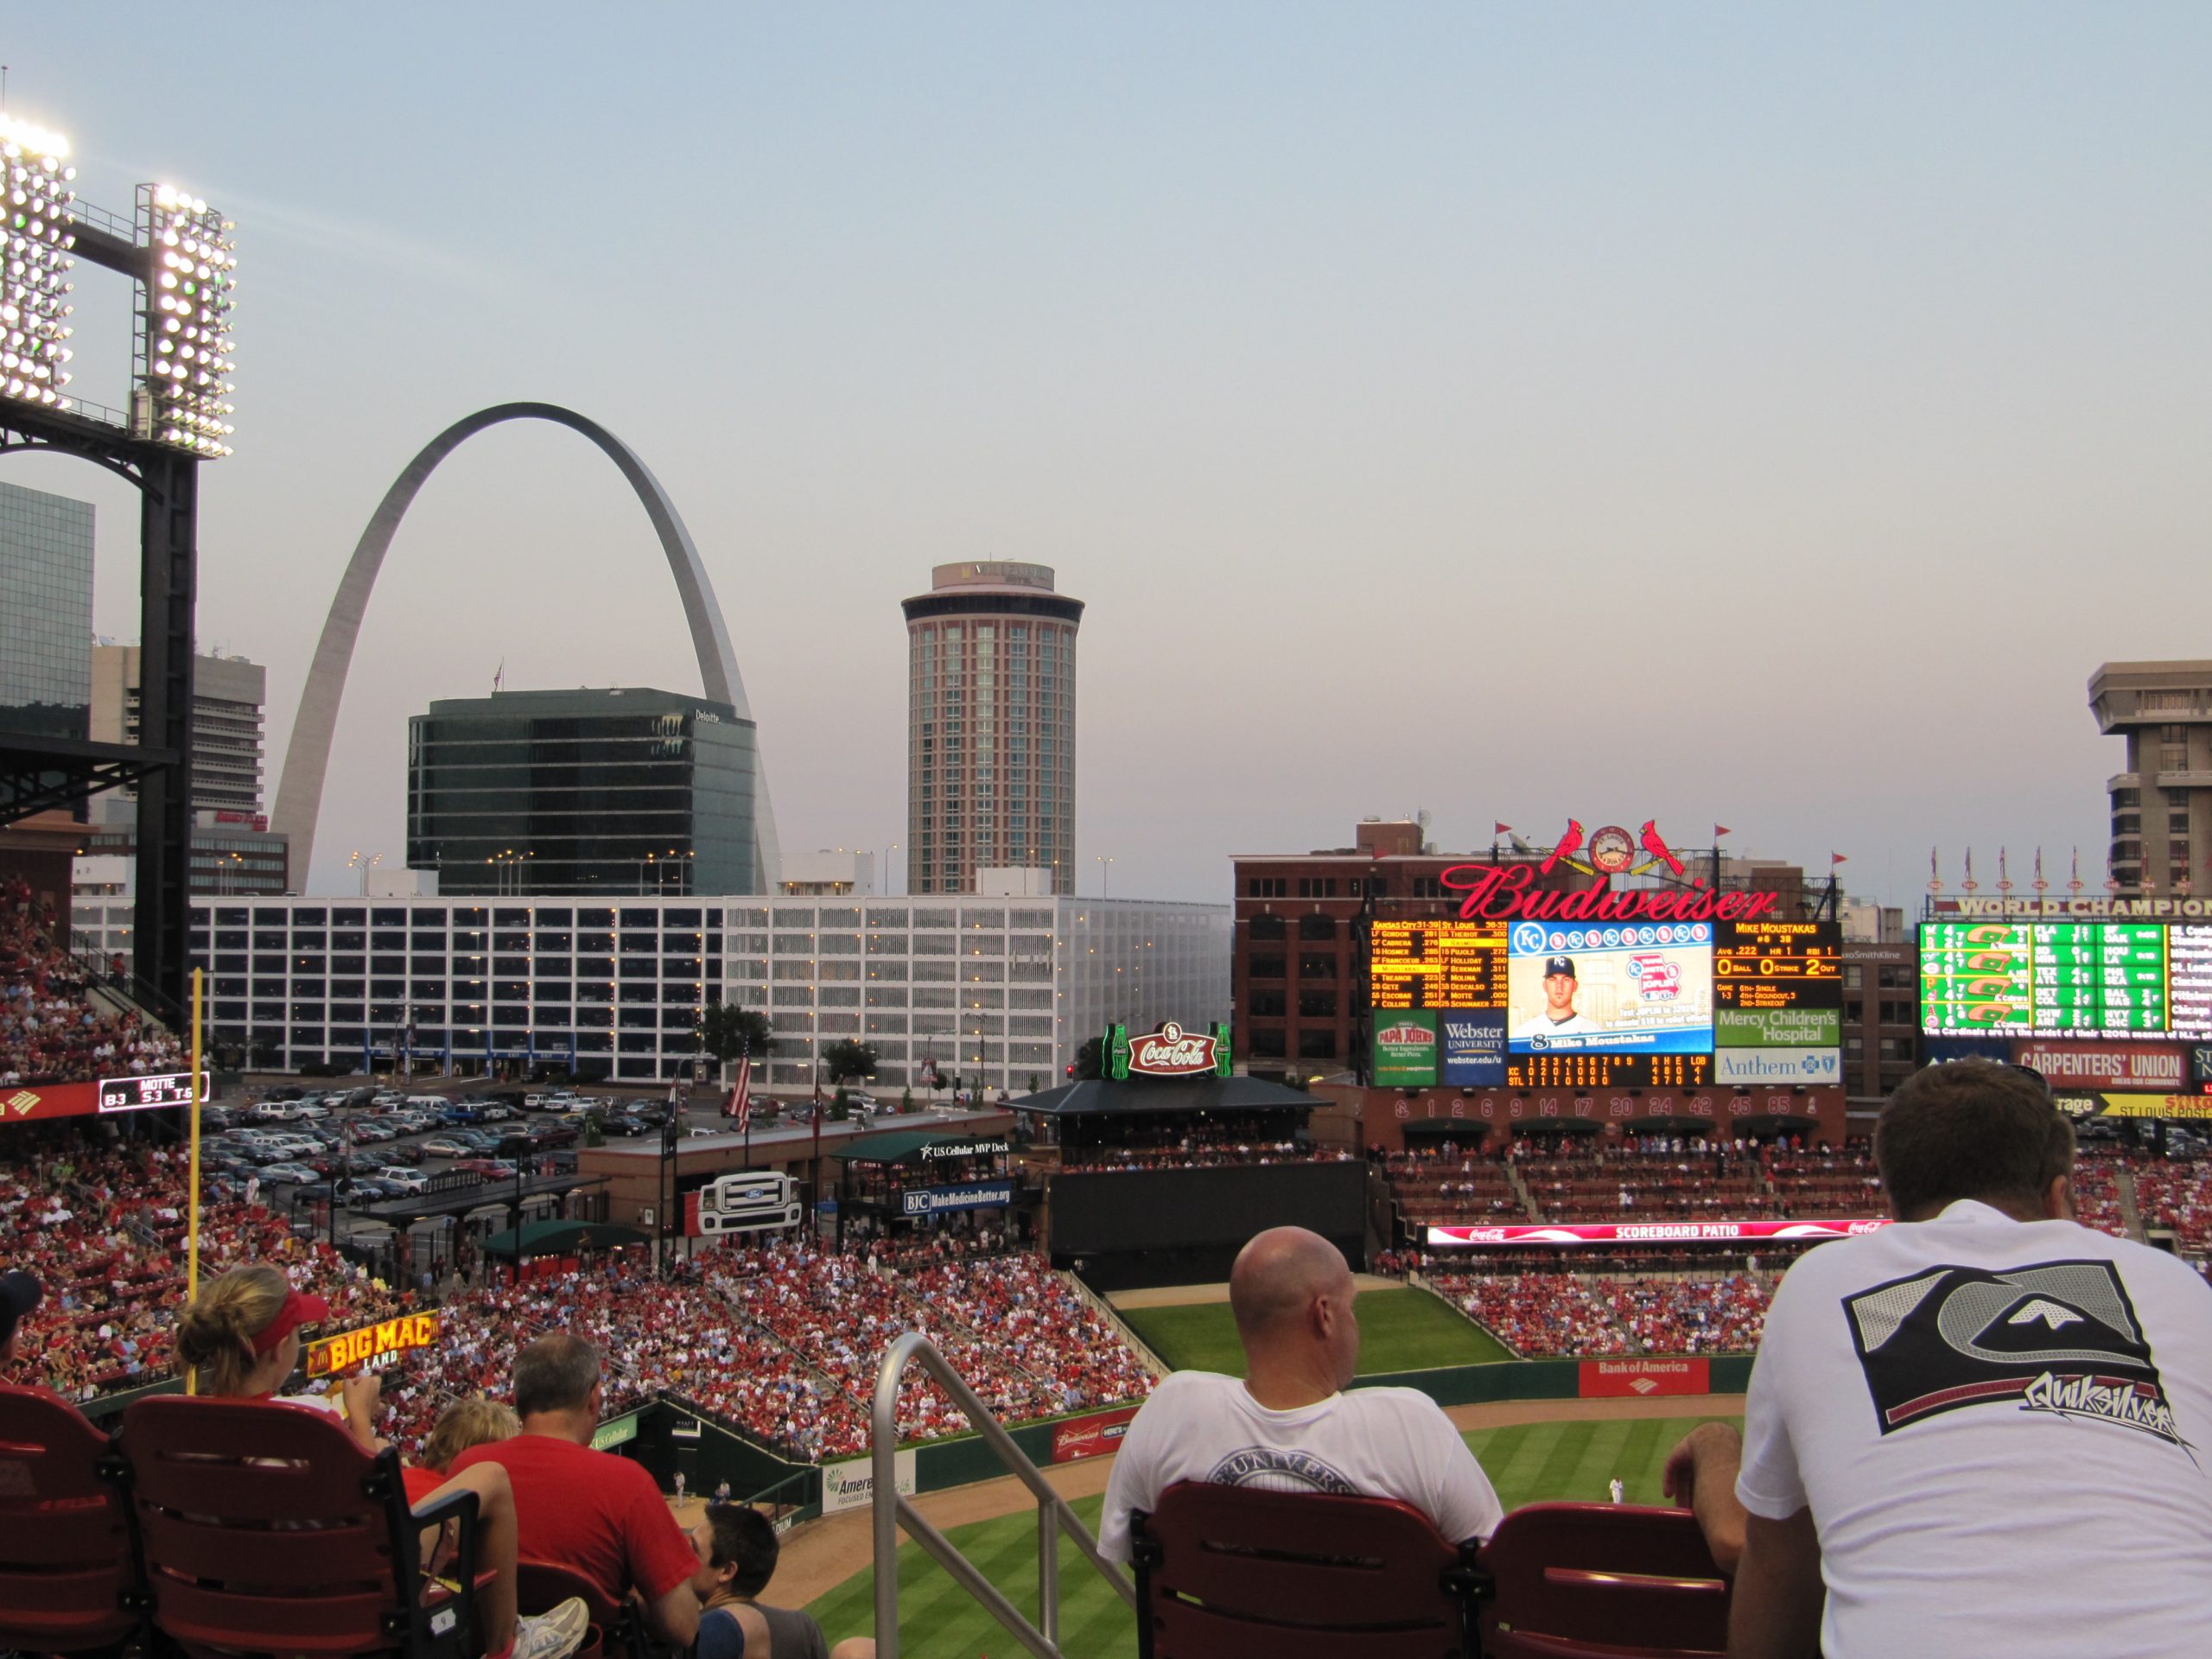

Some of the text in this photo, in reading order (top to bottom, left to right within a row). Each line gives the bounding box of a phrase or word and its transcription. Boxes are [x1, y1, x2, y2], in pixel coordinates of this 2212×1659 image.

[696, 709, 720, 724] Deloitte
[1440, 864, 1777, 920] Budweiser
[1957, 899, 2060, 916] WORLD
[1736, 923, 1816, 933] MIKE MOUSTAKAS
[1806, 959, 1820, 975] 2
[1719, 1012, 1764, 1027] Mercy
[1770, 1011, 1836, 1026] Children's
[1379, 1028, 1402, 1044] PAPA
[1445, 1023, 1503, 1039] Webster
[1763, 1027, 1821, 1044] Hospital
[1923, 1027, 1940, 1036] The
[1942, 1027, 1986, 1036] Cardinals
[2005, 1027, 2014, 1036] in
[2017, 1027, 2032, 1036] the
[2034, 1028, 2063, 1037] midst
[2063, 1028, 2074, 1037] of
[2075, 1028, 2100, 1037] their
[2101, 1029, 2130, 1038] 120th
[2166, 1030, 2177, 1039] of
[1447, 1039, 1503, 1049] UNIVERSITY
[1531, 1033, 1656, 1050] 8 Mike Moustakas
[1140, 1039, 1206, 1066] Coca-Cola
[1691, 1057, 1706, 1065] LOB
[1720, 1055, 1797, 1076] Anthem
[2131, 1053, 2180, 1077] UNION
[1509, 1067, 1519, 1077] KC
[141, 1077, 175, 1091] MOTTE
[1509, 1077, 1524, 1086] STL
[1427, 1096, 1790, 1117] 1 2 6 9 14 17 20 24 42 45 85
[2057, 1096, 2093, 1117] rage
[945, 1144, 974, 1156] Cellular
[975, 1143, 991, 1154] MVP
[992, 1142, 1009, 1152] Deck
[907, 1190, 1010, 1211] BJC MakeMedicineBetter.org
[1469, 1224, 1739, 1241] Coca-Cola SCOREBOARD PATIO
[330, 1317, 431, 1371] BIG MAC
[364, 1350, 397, 1370] LAND
[1599, 1361, 1688, 1374] Bank of America
[838, 1477, 873, 1495] Amere
[838, 1494, 864, 1505] FOCUSED
